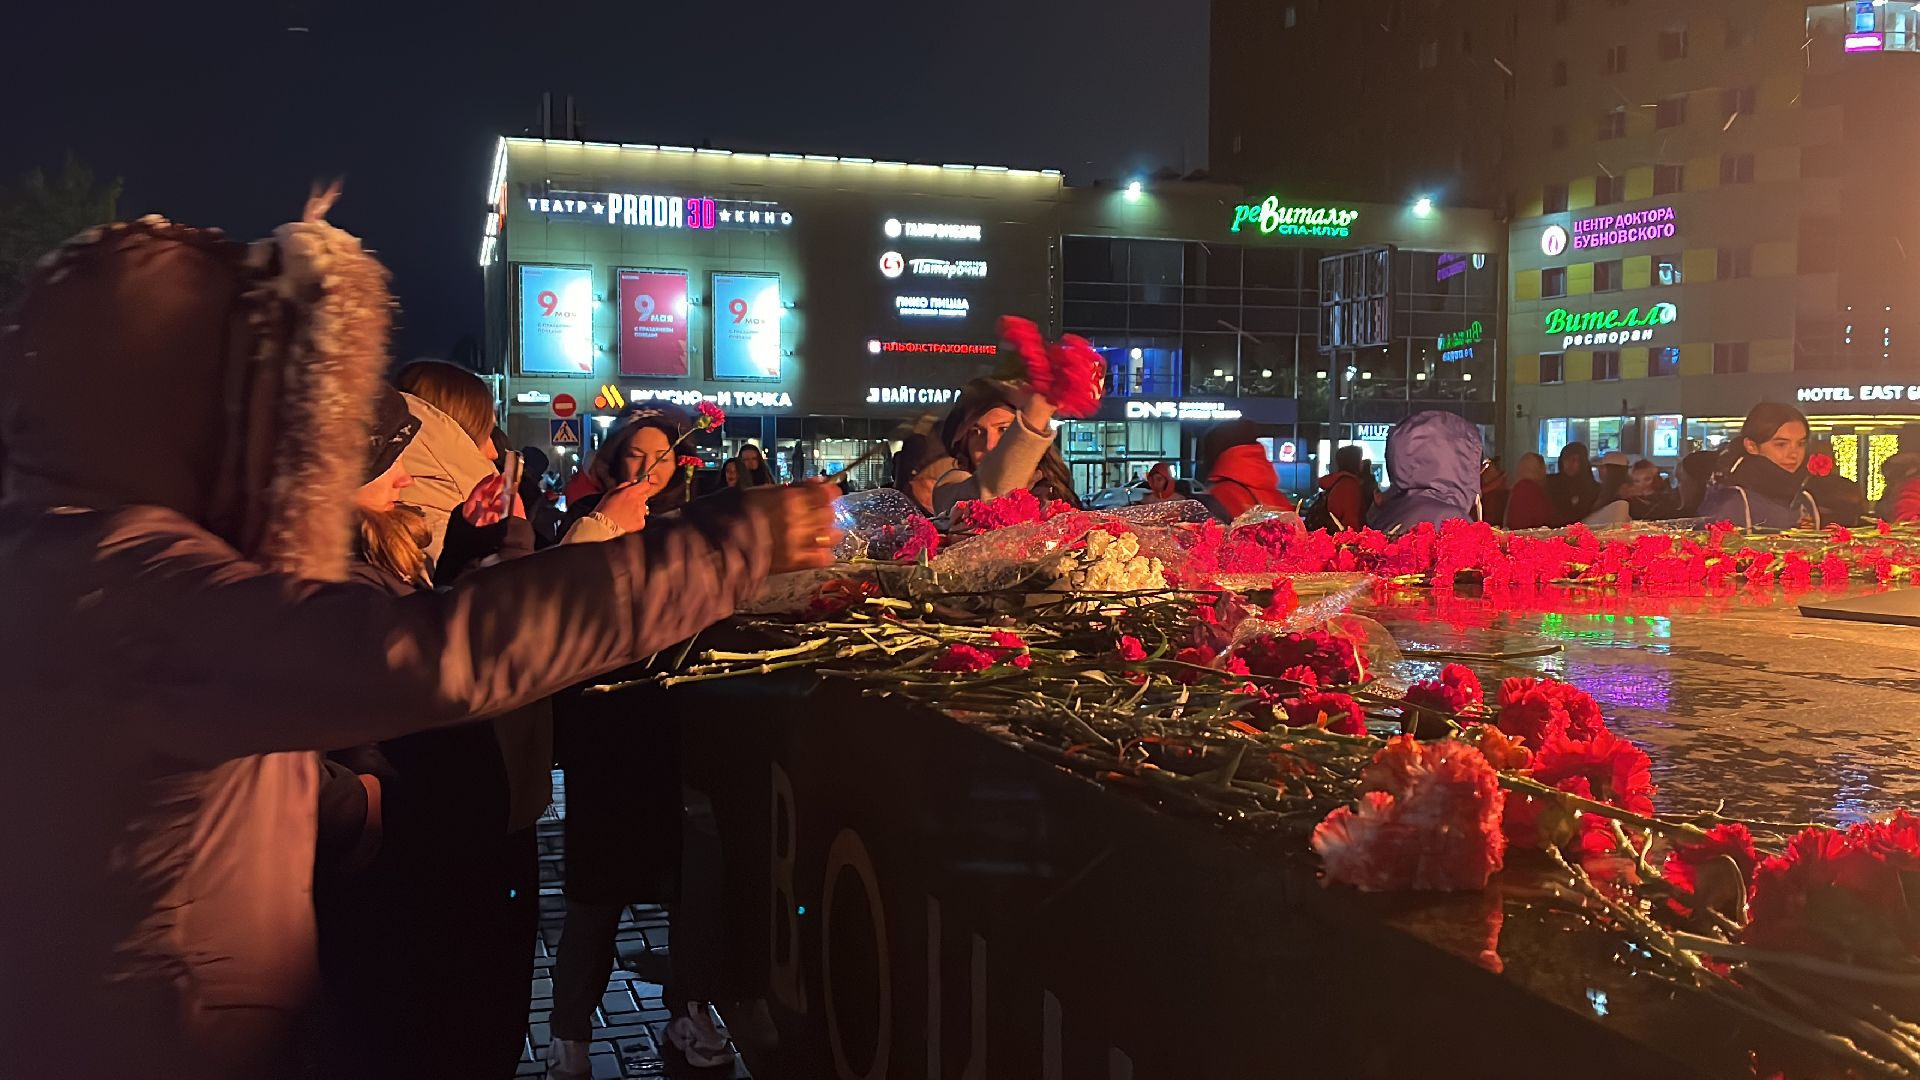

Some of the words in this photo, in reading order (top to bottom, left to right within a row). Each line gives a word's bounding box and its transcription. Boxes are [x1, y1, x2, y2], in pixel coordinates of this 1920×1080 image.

[527, 198, 589, 213] ТЕАТР
[608, 193, 683, 228] PRADA
[687, 197, 716, 229] 3D
[735, 210, 793, 225] КИНО
[1574, 215, 1615, 234] ЦЕНТР
[1615, 207, 1675, 229] ДОКТОРА
[1278, 224, 1349, 238] СПА-КЛУБ
[1573, 223, 1675, 250] БУБНОВСКОГО
[537, 290, 558, 316] 9
[634, 294, 655, 321] 9
[728, 298, 748, 324] 9
[883, 341, 997, 354] АЛЬФАСТРАХОВАНИЕ
[1563, 328, 1653, 350] ресторан
[733, 391, 793, 407] ТОЧКА
[881, 386, 917, 403] ВАЙТ
[918, 388, 952, 403] СТАР
[1797, 387, 1855, 402] HOTEL
[1859, 385, 1905, 401] EAST
[1127, 401, 1178, 418] DNS
[1358, 424, 1389, 437] MIUZ
